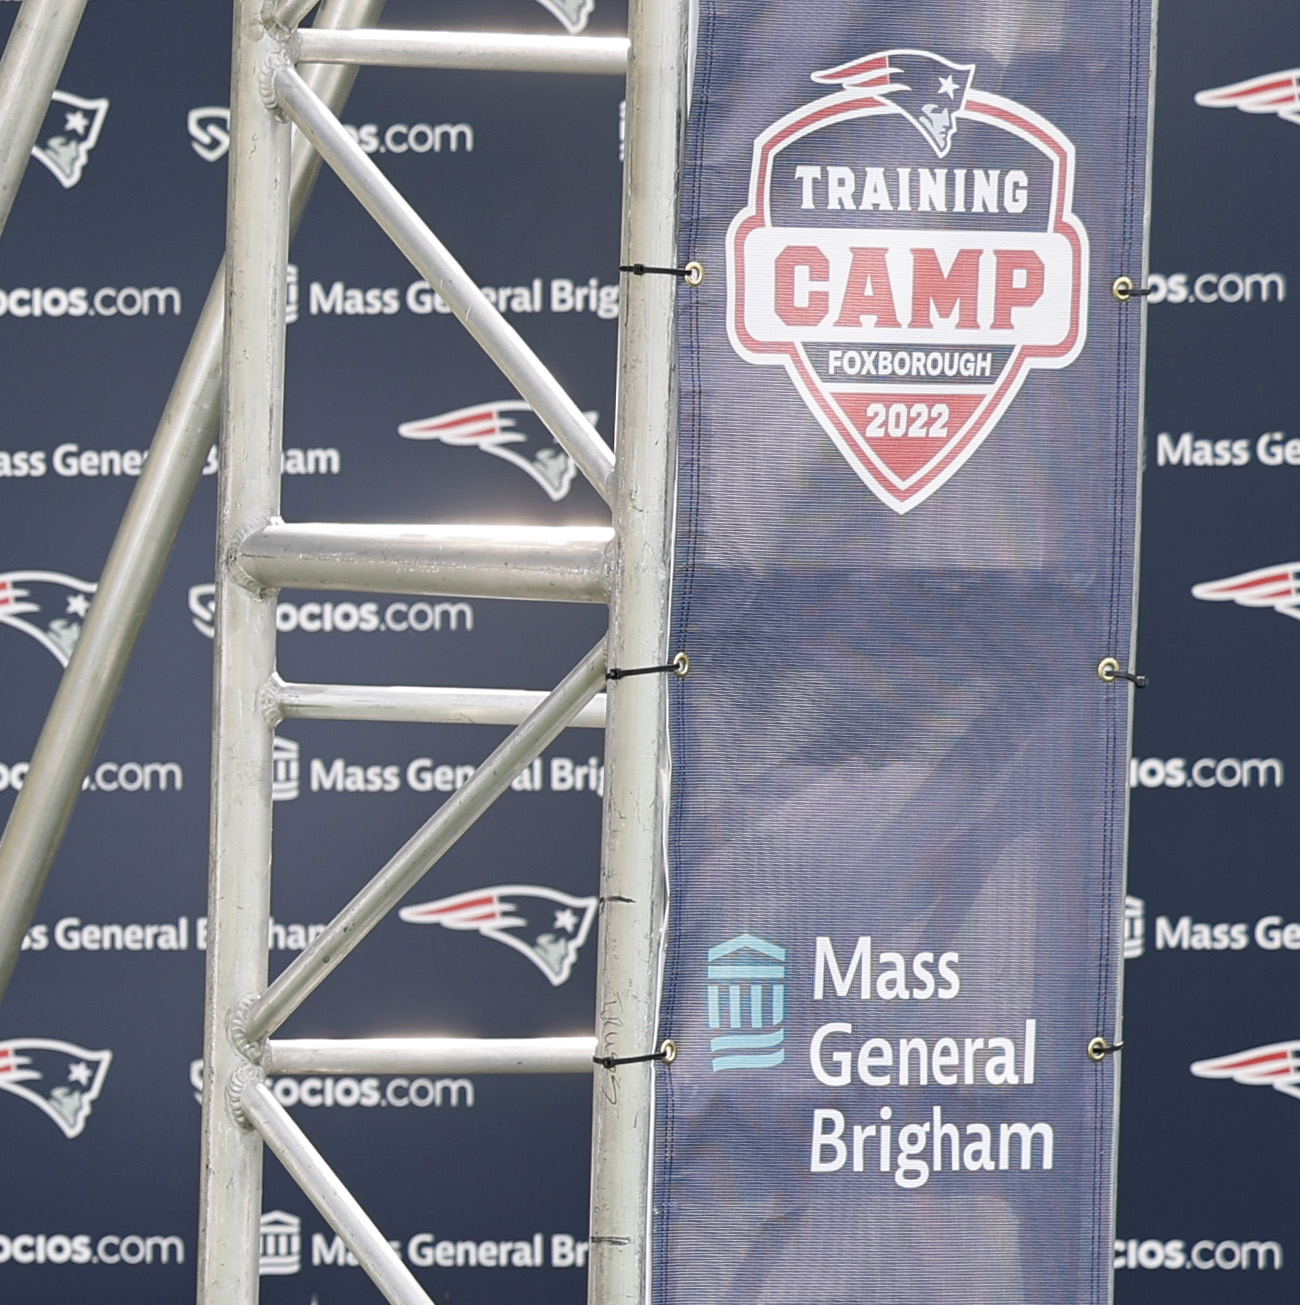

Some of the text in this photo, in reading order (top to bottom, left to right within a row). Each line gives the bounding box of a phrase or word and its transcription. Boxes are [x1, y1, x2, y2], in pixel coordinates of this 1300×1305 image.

[345, 122, 473, 153] s.com
[794, 165, 1028, 215] TRAINING
[309, 278, 620, 319] Mass Geeral Brig
[773, 245, 1046, 330] CAMP
[828, 350, 992, 378] FOXBOROUGH
[865, 402, 948, 438] 2022
[52, 443, 149, 477] Gene
[1157, 431, 1250, 466] Mass
[276, 601, 474, 632] ocios.com
[310, 758, 400, 792] Mass
[406, 757, 542, 792] Genal
[1130, 757, 1284, 788] ios.com
[54, 916, 189, 951] General
[1155, 916, 1249, 951] Mass
[813, 935, 961, 1000] Mass
[809, 1019, 1037, 1087] General
[810, 1105, 1054, 1188] Brigham
[407, 1232, 544, 1267] General
[1113, 1239, 1284, 1270] cios.com
